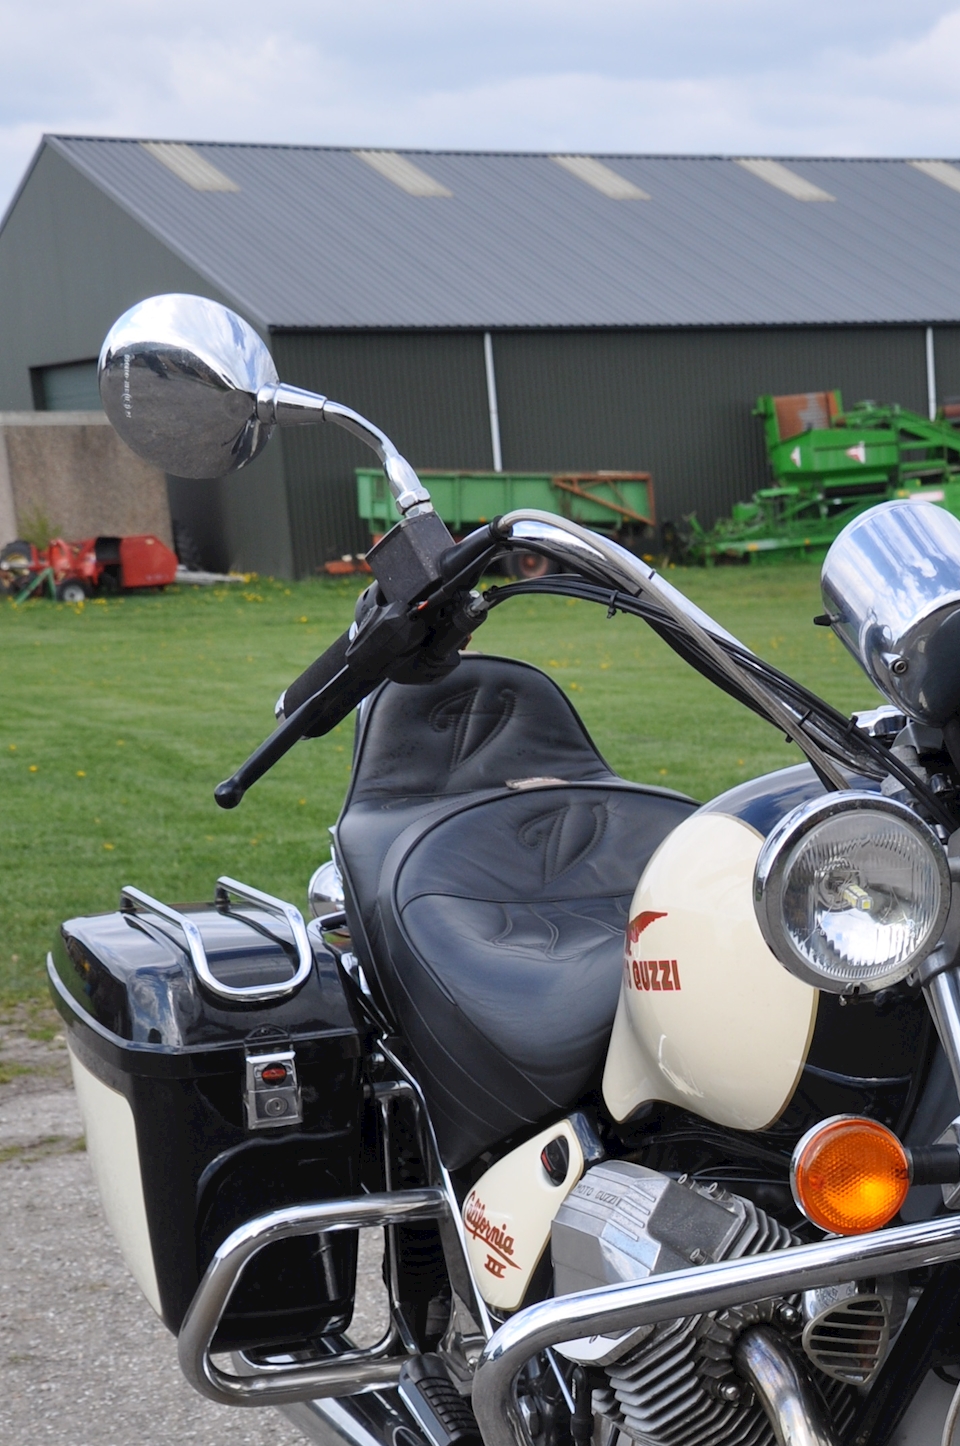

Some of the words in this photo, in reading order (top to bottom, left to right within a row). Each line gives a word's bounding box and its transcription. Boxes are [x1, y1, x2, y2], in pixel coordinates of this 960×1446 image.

[632, 959, 682, 992] GUZZI
[574, 1183, 595, 1197] MOTO
[594, 1190, 618, 1206] GUZZI
[484, 1253, 507, 1279] III
